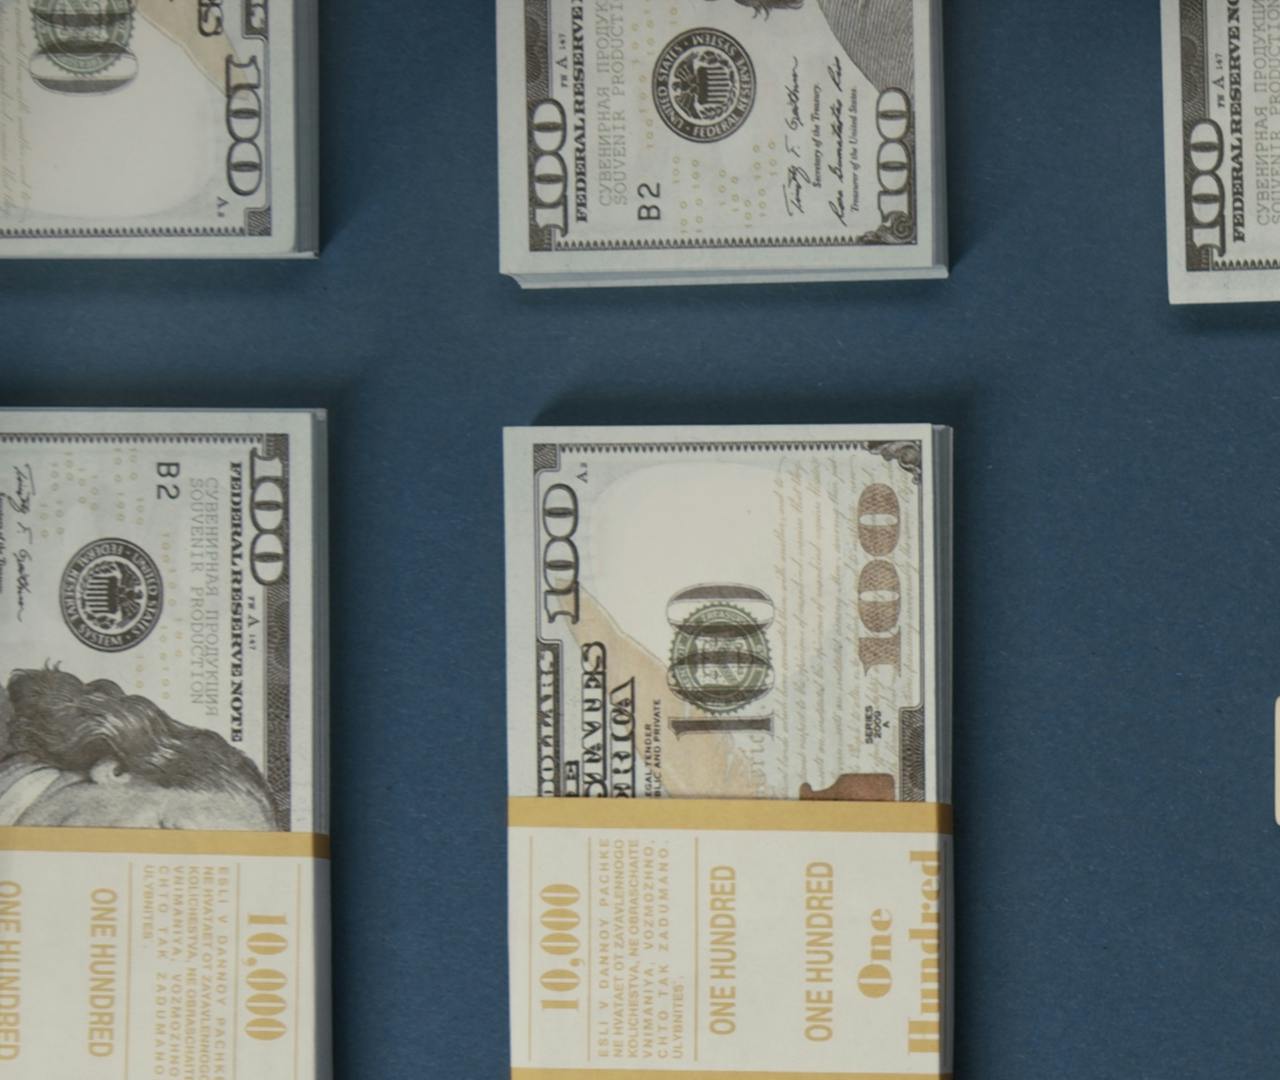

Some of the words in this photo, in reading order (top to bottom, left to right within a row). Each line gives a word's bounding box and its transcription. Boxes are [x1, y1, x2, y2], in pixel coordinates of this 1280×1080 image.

[570, 6, 586, 114] RESERVE
[1227, 26, 1243, 134] RESERVE
[224, 53, 263, 197] 100
[531, 97, 569, 237] 100
[573, 117, 588, 222] FEDERAL
[875, 87, 912, 223] 100
[1189, 117, 1226, 258] 100
[1230, 137, 1245, 243] FEDERAL
[230, 461, 244, 566] FEDERAL
[249, 447, 286, 587] 100
[542, 483, 580, 626] 100
[229, 569, 244, 677] RESERVE
[857, 482, 902, 678] 100
[229, 680, 244, 742] NOTE
[665, 582, 776, 739] 100
[864, 705, 874, 744] SERIES
[874, 710, 882, 739] 2009
[90, 888, 118, 937] ONE
[539, 883, 586, 1012] 10,000
[710, 865, 737, 980] HUNDRED
[804, 861, 834, 983] HUNDRED
[856, 908, 894, 999] One
[906, 850, 942, 1056] Hundred
[86, 944, 116, 1058] HUNDRED
[239, 912, 288, 1042] 10,000
[709, 986, 736, 1036] ONE
[804, 990, 833, 1042] ONE
